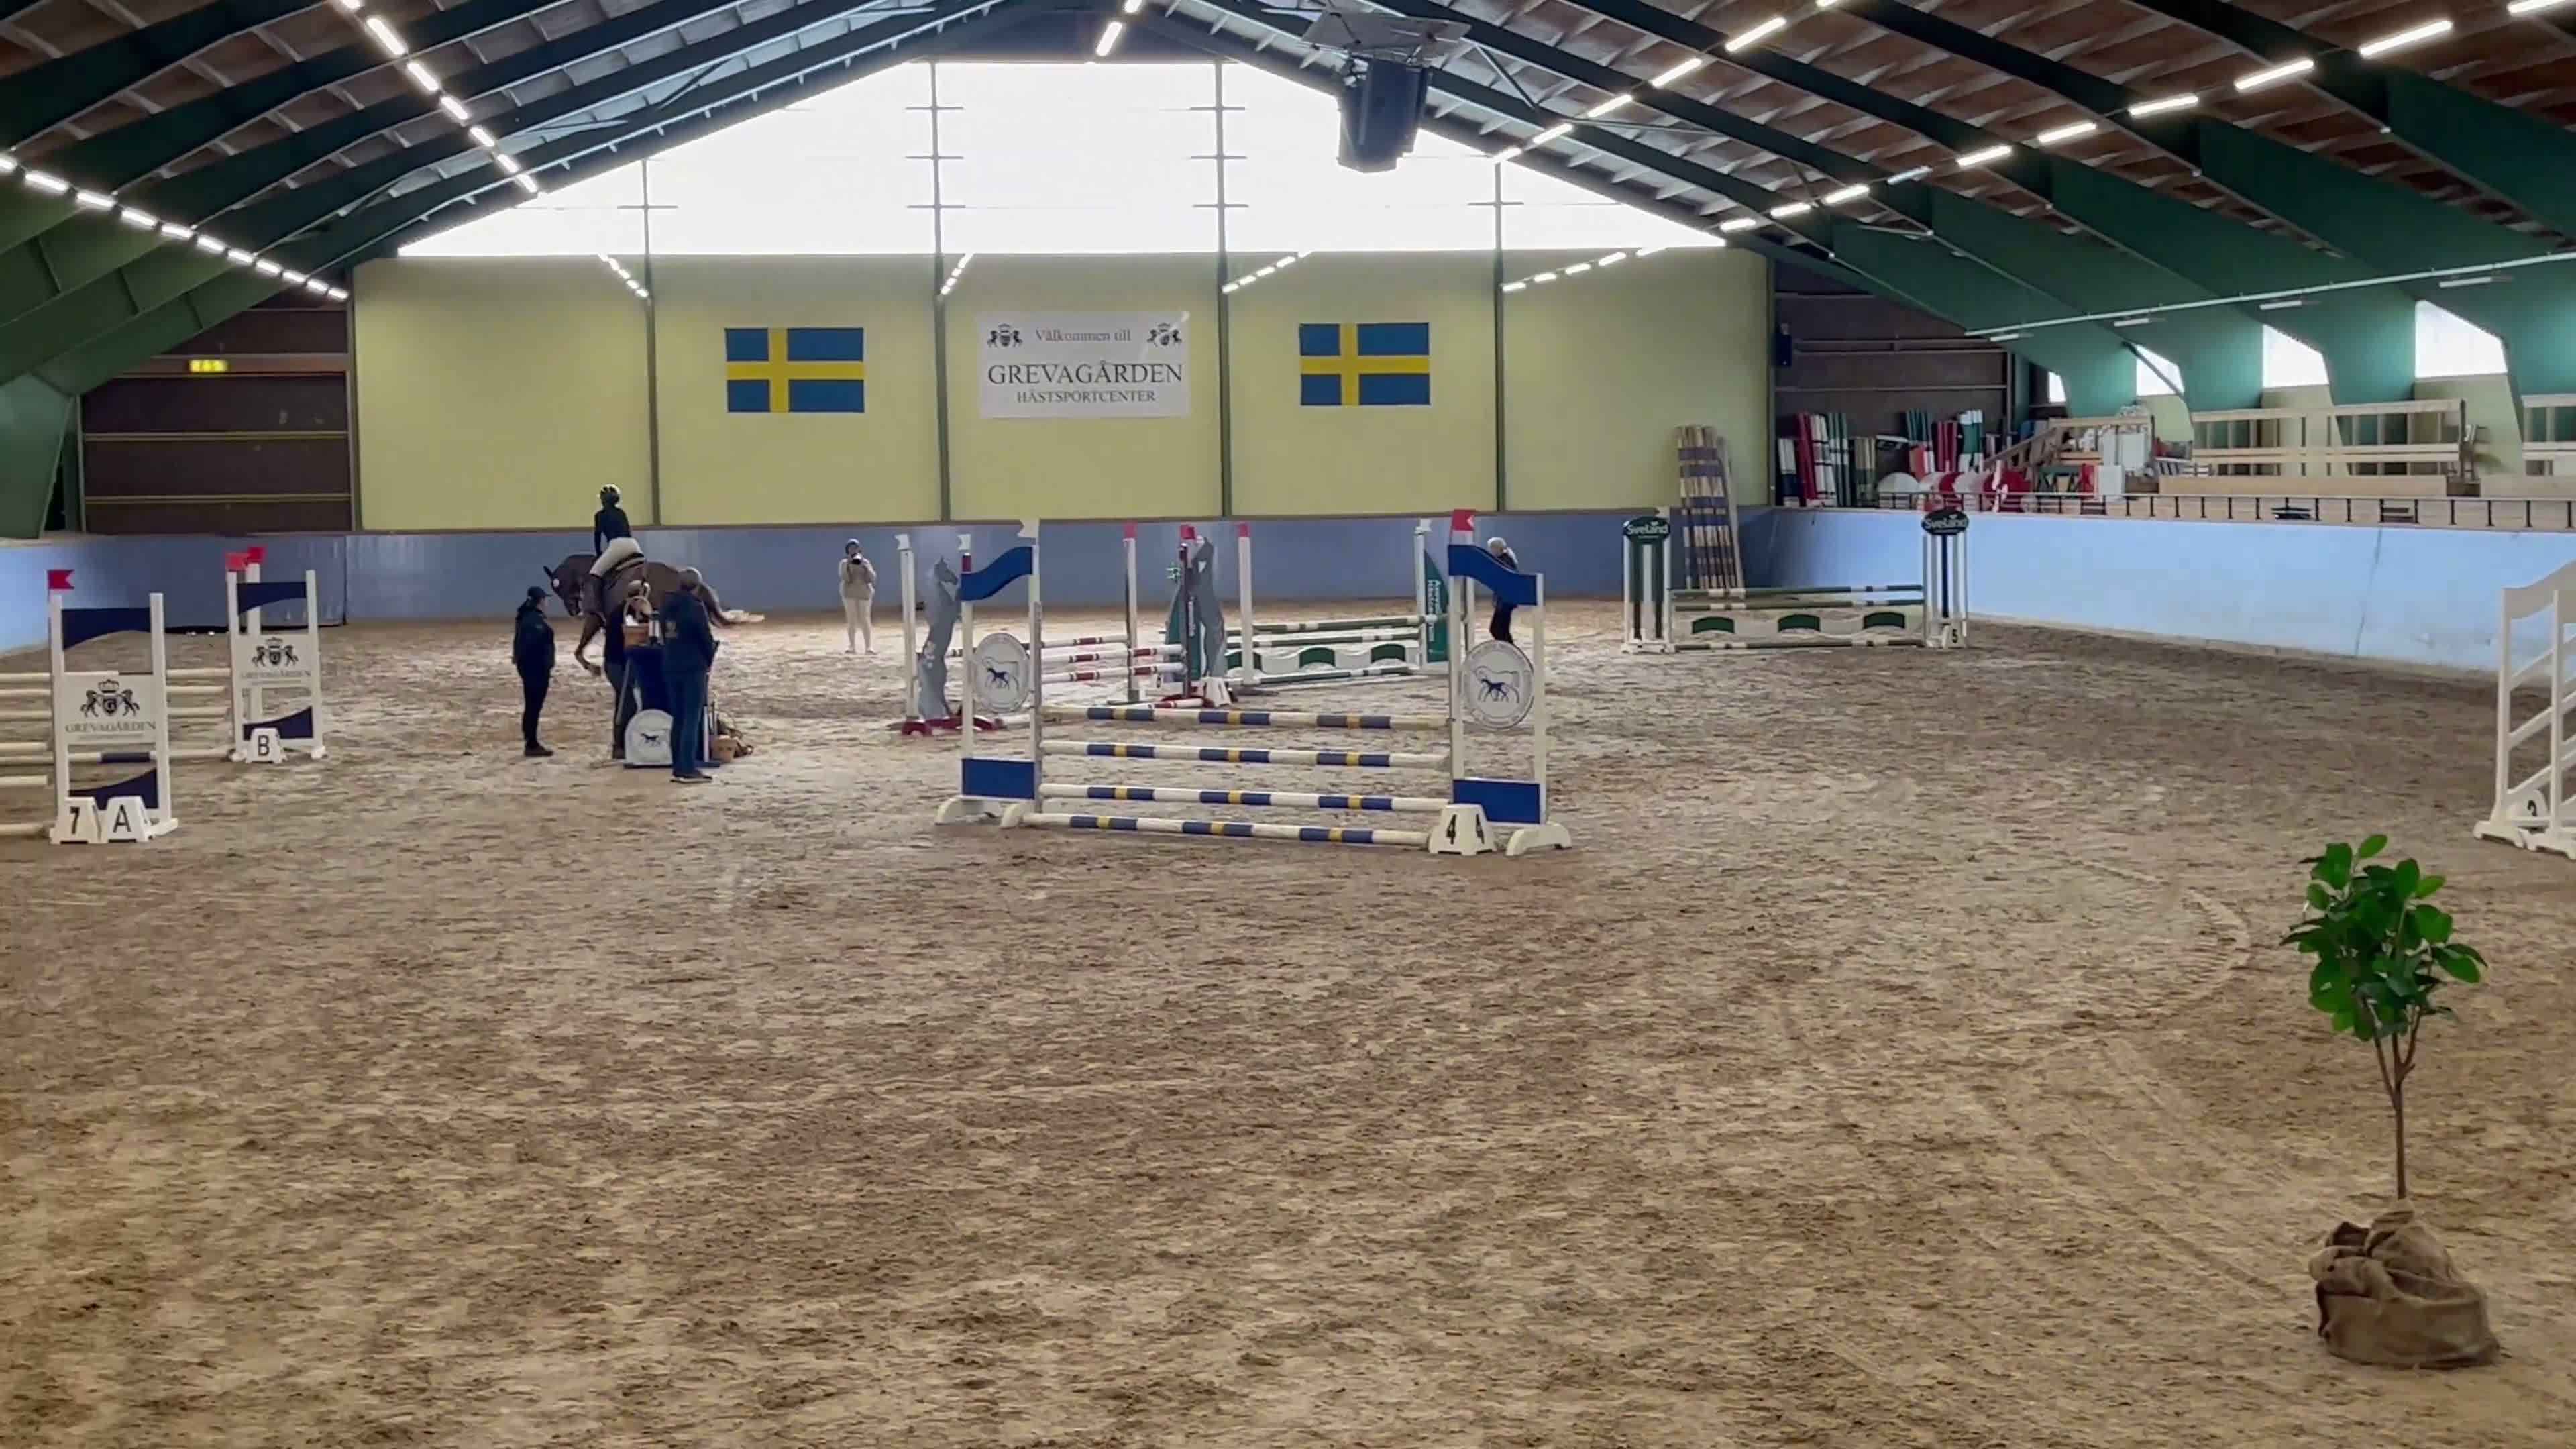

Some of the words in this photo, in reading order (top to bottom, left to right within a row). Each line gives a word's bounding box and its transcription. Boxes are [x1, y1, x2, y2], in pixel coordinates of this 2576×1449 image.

[1035, 329, 1111, 342] Välkommen
[1114, 329, 1132, 342] till
[987, 360, 1182, 385] GREVAGÅRDEN
[1016, 389, 1156, 403] HÄSTSPORTCENTER
[1951, 629, 1959, 644] 5
[258, 735, 270, 757] B
[70, 806, 81, 835] 7
[112, 804, 132, 833] A
[1445, 814, 1458, 845] 4
[1475, 814, 1485, 845] 4
